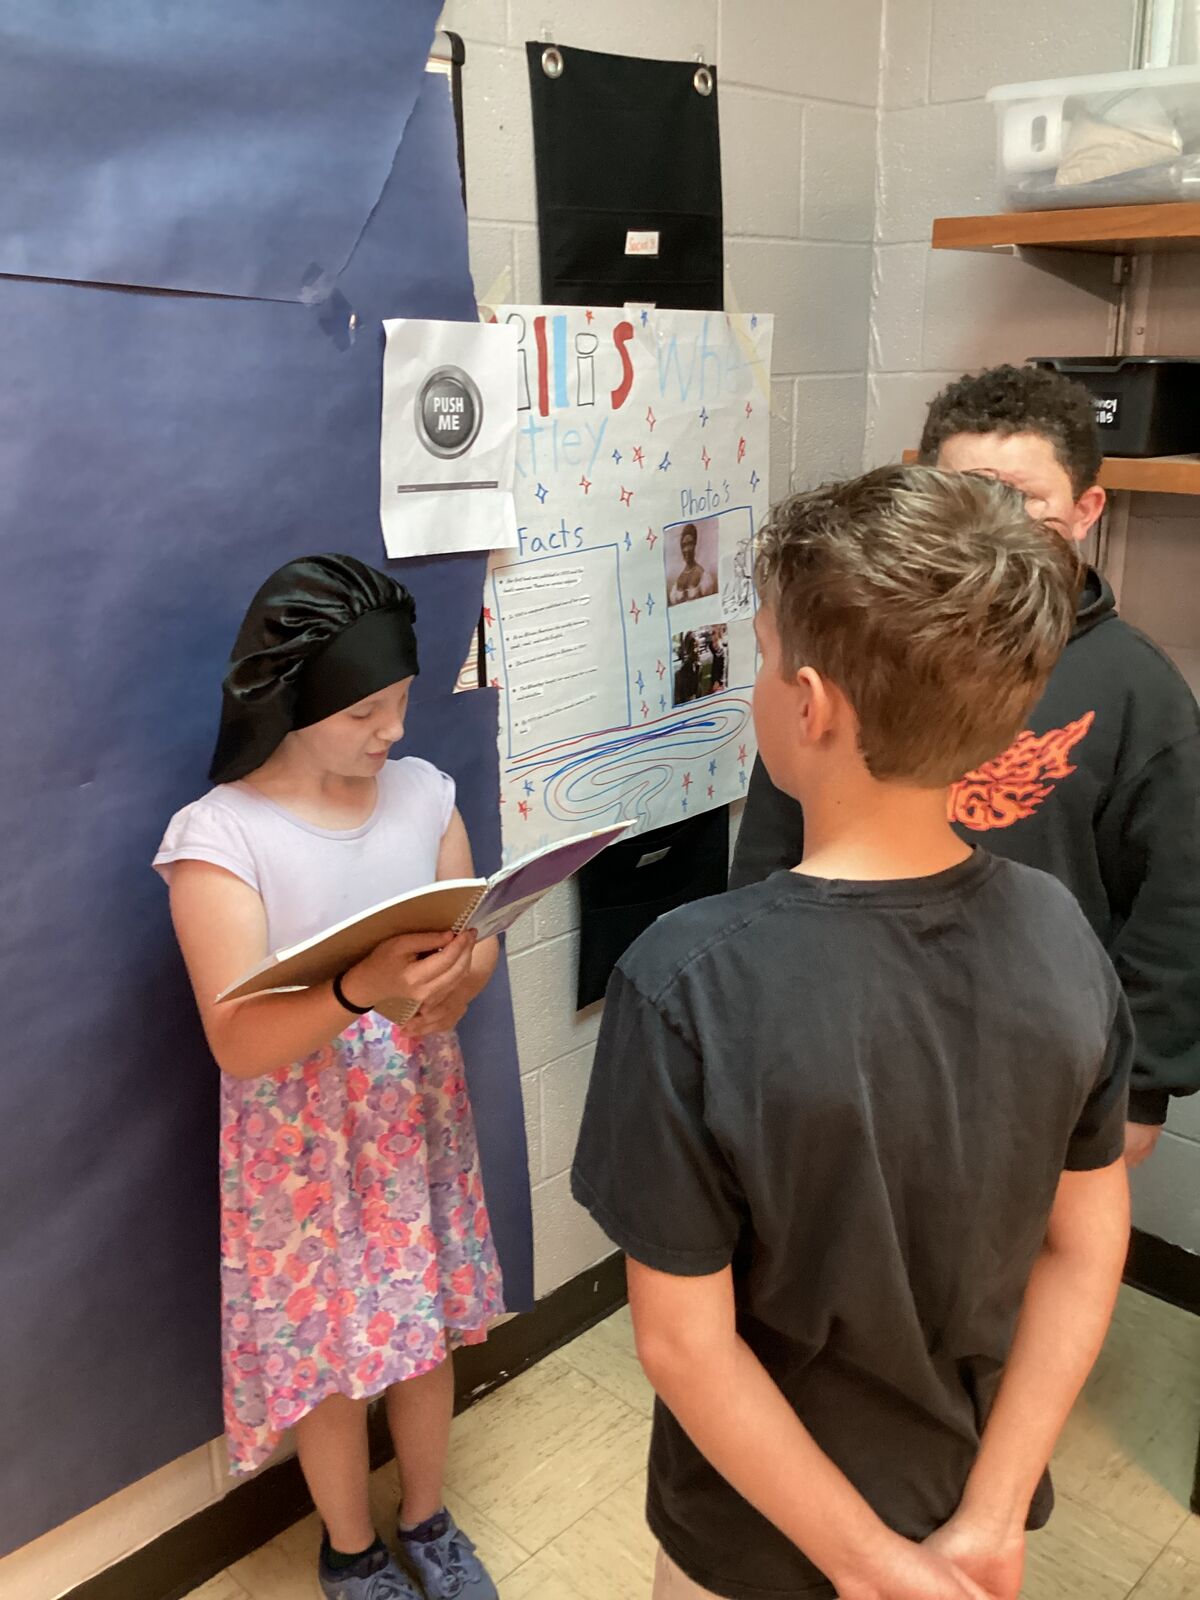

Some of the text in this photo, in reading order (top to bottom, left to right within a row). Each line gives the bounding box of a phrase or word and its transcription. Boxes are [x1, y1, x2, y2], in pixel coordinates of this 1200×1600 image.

[434, 397, 464, 413] PUSH
[438, 415, 460, 430] ME
[515, 414, 609, 479] tley
[680, 478, 731, 518] Photo's
[518, 519, 584, 556] Facts
